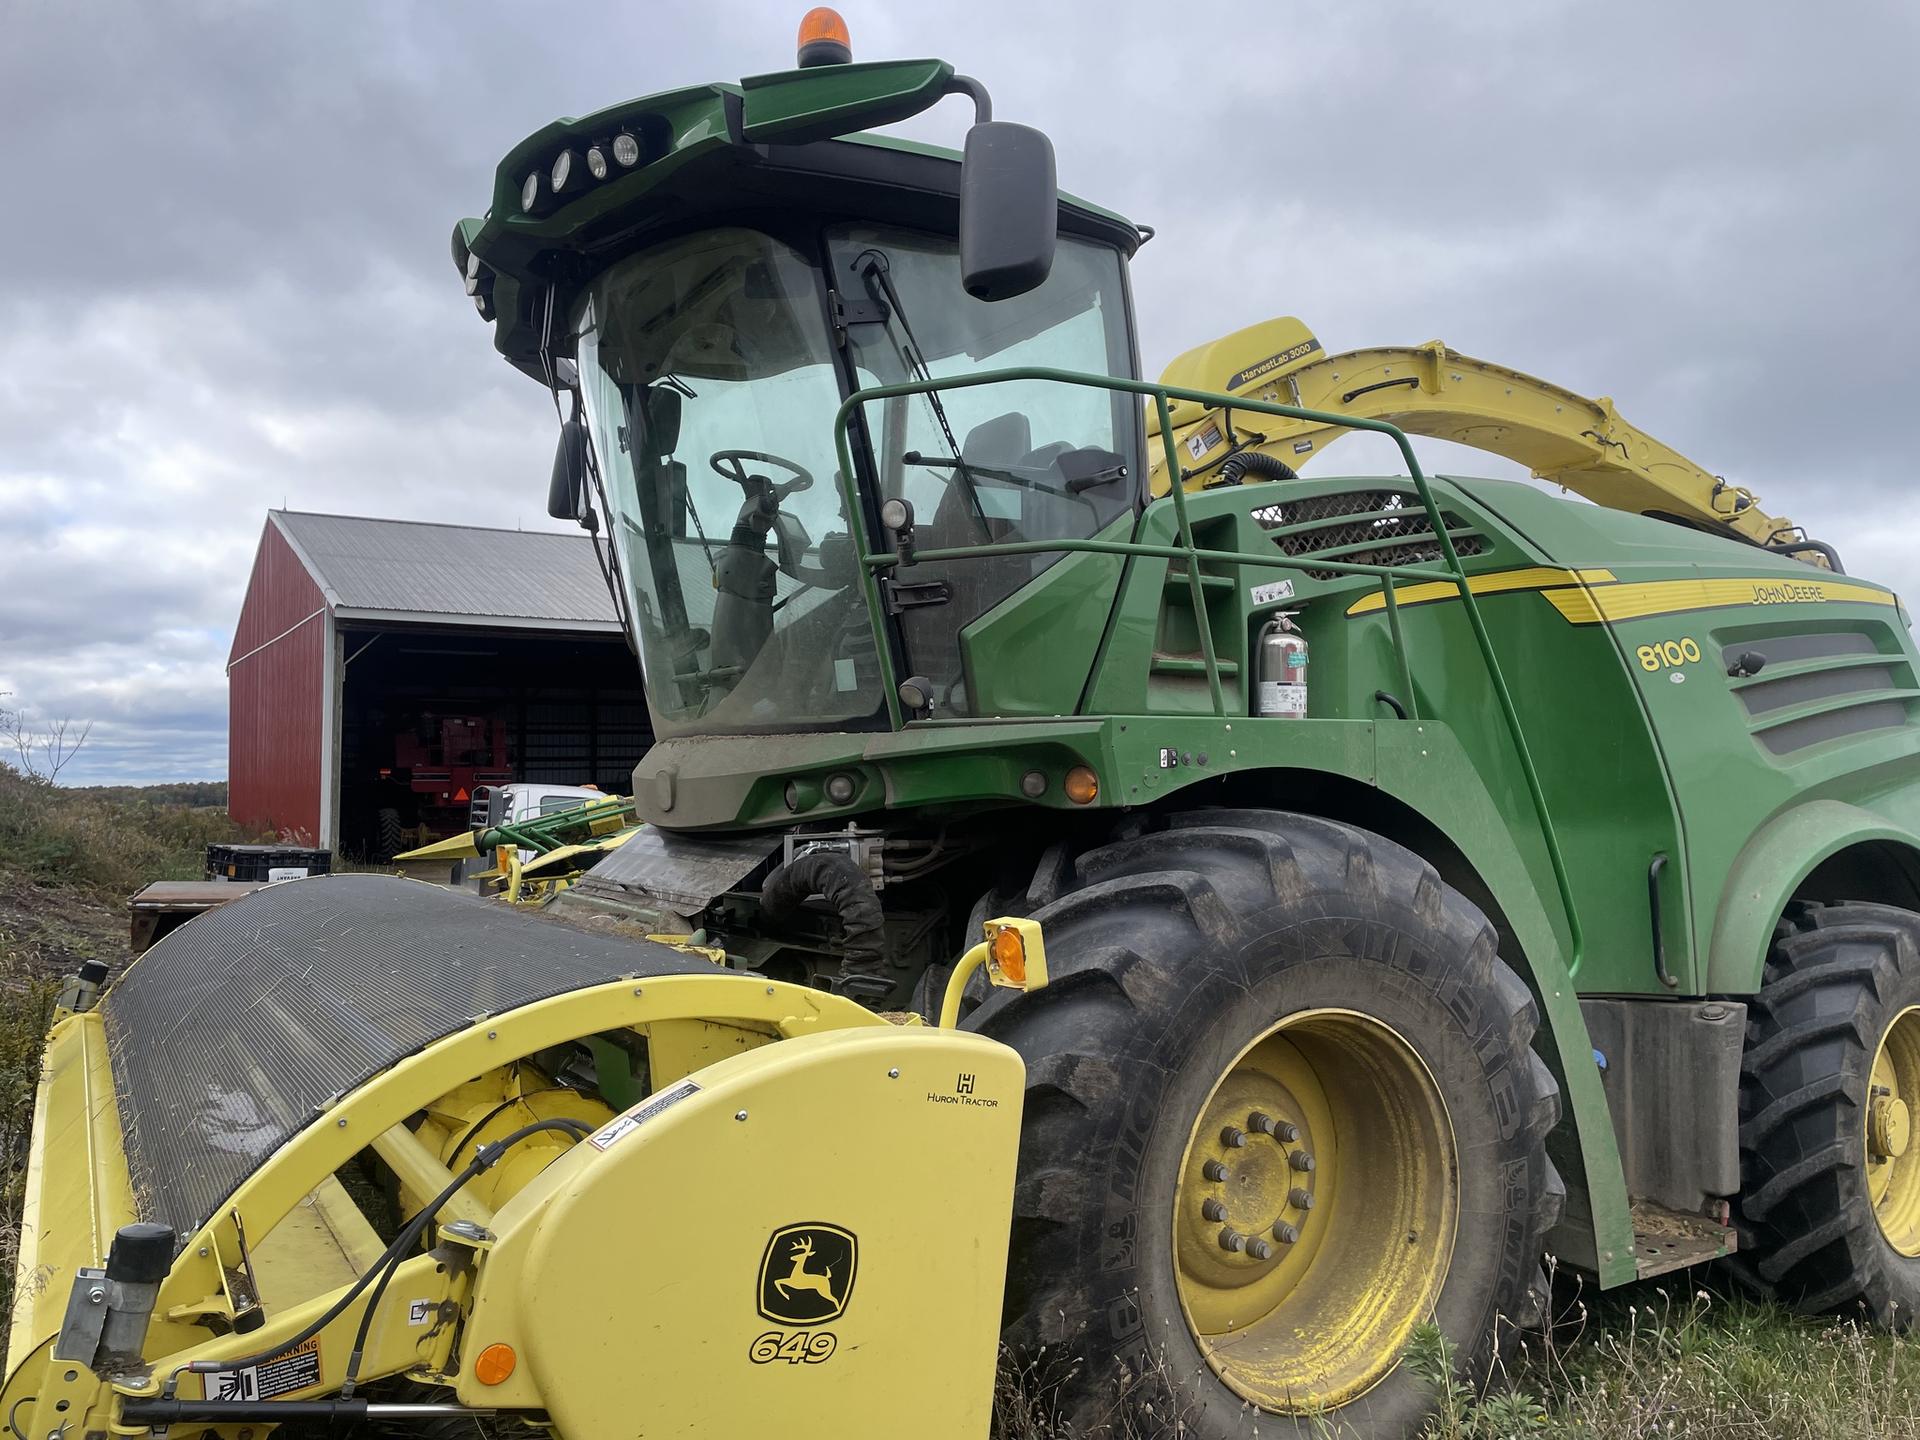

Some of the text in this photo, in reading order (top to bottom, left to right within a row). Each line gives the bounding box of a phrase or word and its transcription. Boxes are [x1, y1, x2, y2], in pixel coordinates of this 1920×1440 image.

[1240, 342, 1312, 382] HarvestLab 3000
[1752, 583, 1827, 605] JOHN DEERE
[1635, 635, 1702, 673] 8100
[927, 1092, 999, 1108] HURON TRACTOR
[749, 1331, 838, 1365] 649
